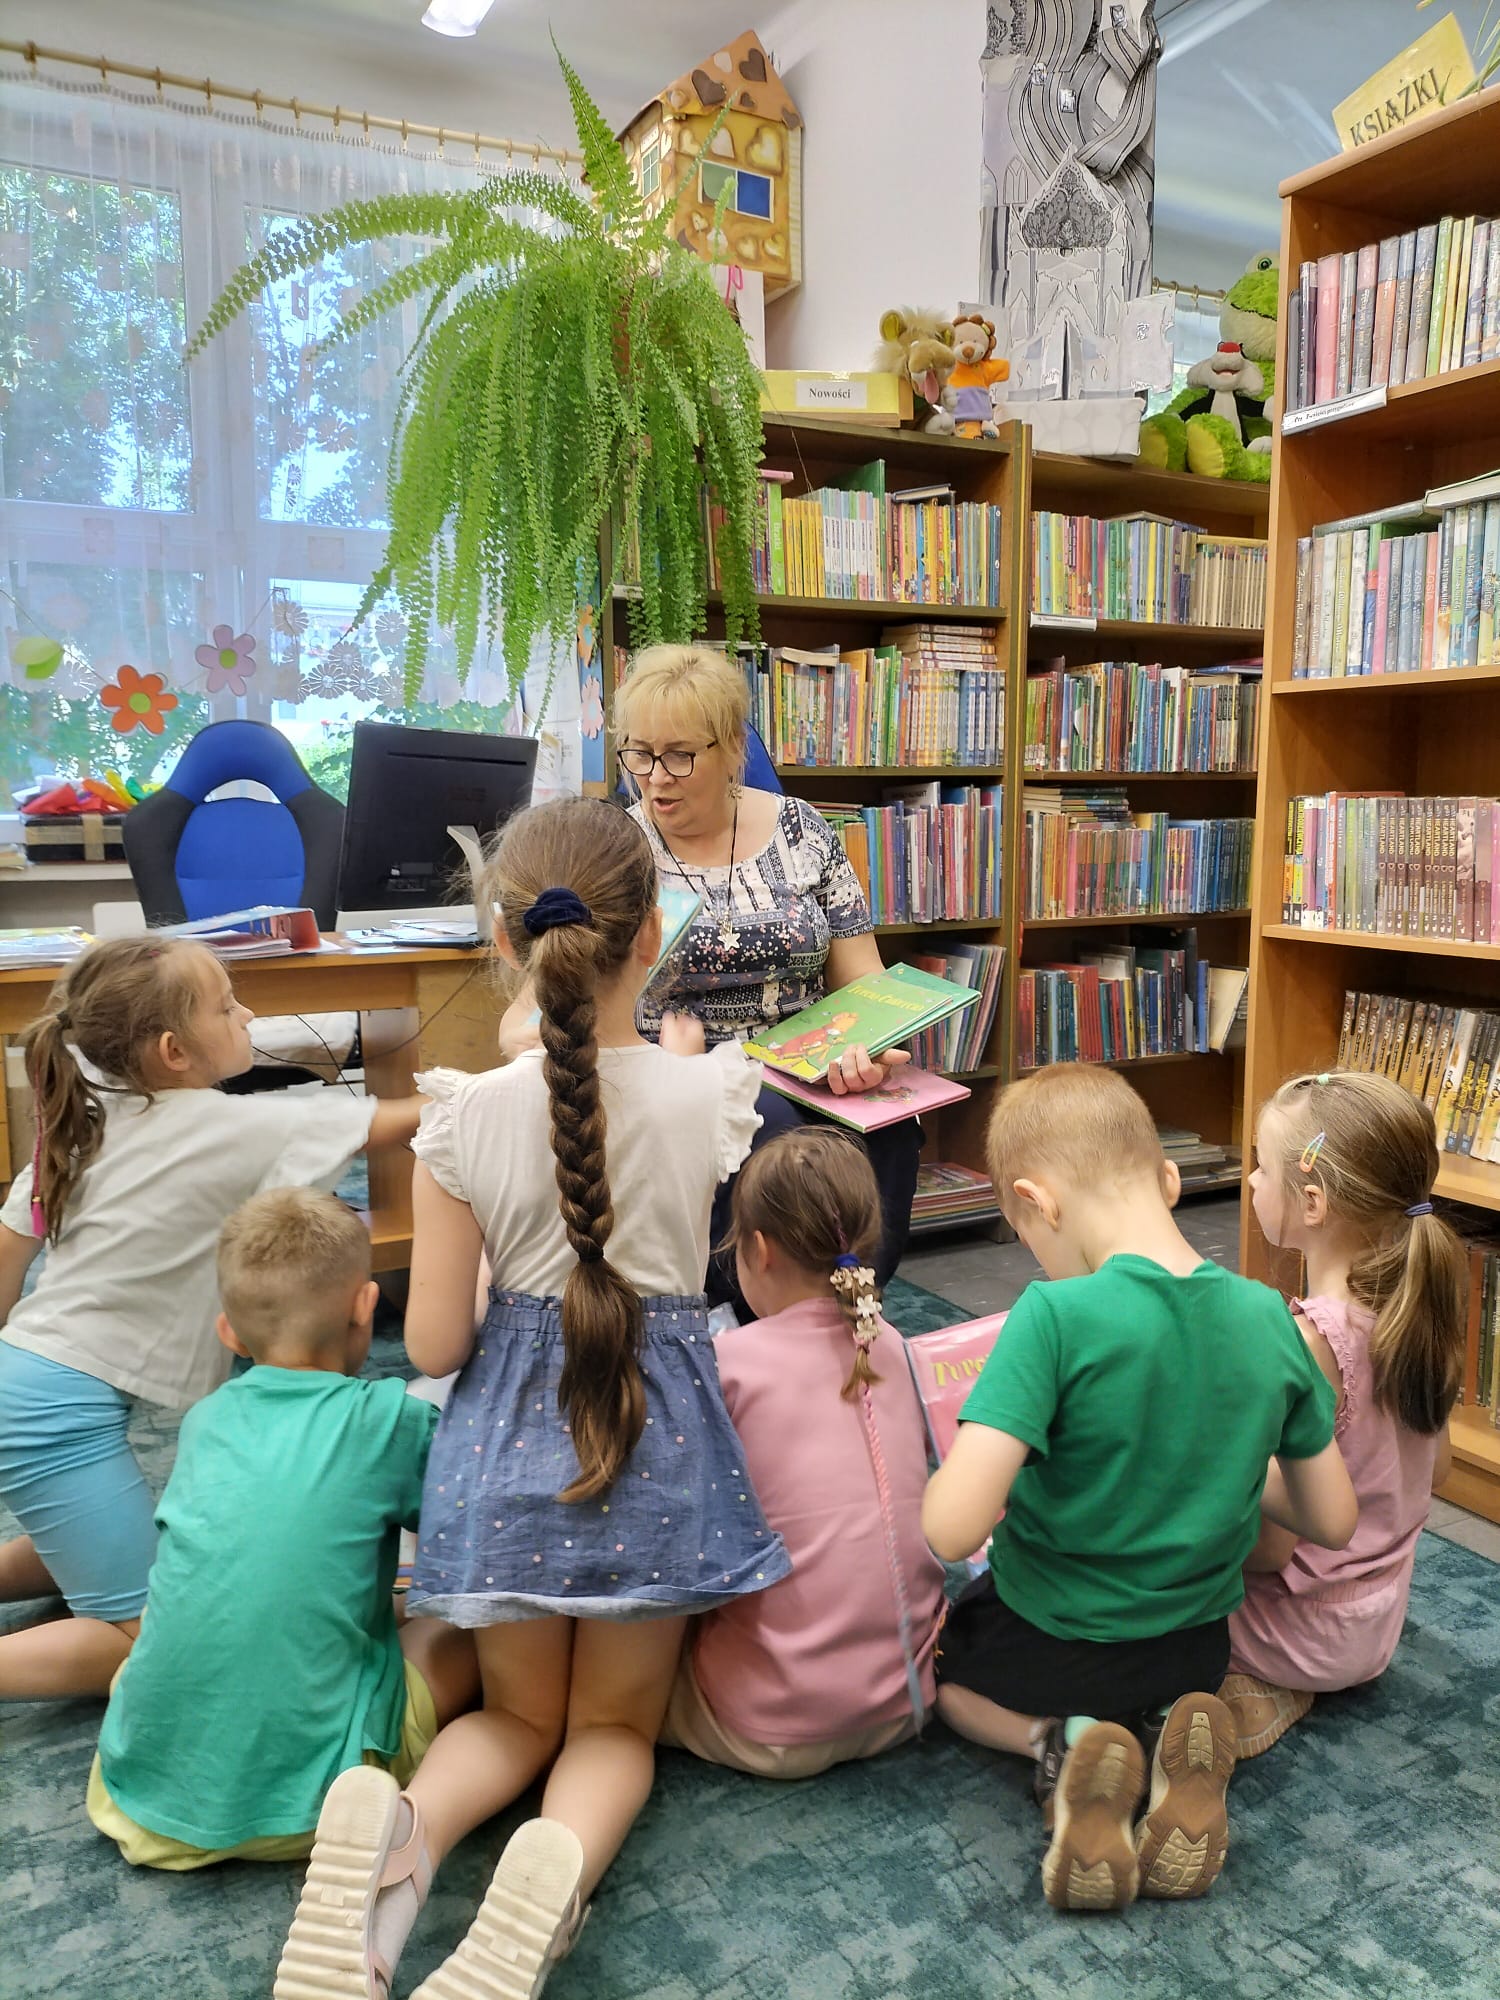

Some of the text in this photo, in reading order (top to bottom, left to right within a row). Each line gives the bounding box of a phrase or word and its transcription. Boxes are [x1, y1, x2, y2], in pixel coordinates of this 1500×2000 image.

[1349, 68, 1440, 147] KSIĄŻKI
[809, 387, 851, 399] Nowości
[1402, 574, 1412, 605] ZOSIA
[1413, 570, 1423, 601] ZOSIA
[1425, 570, 1435, 601] ZOSIA
[1296, 801, 1304, 854] ELEKTRODZIEWCZYNA
